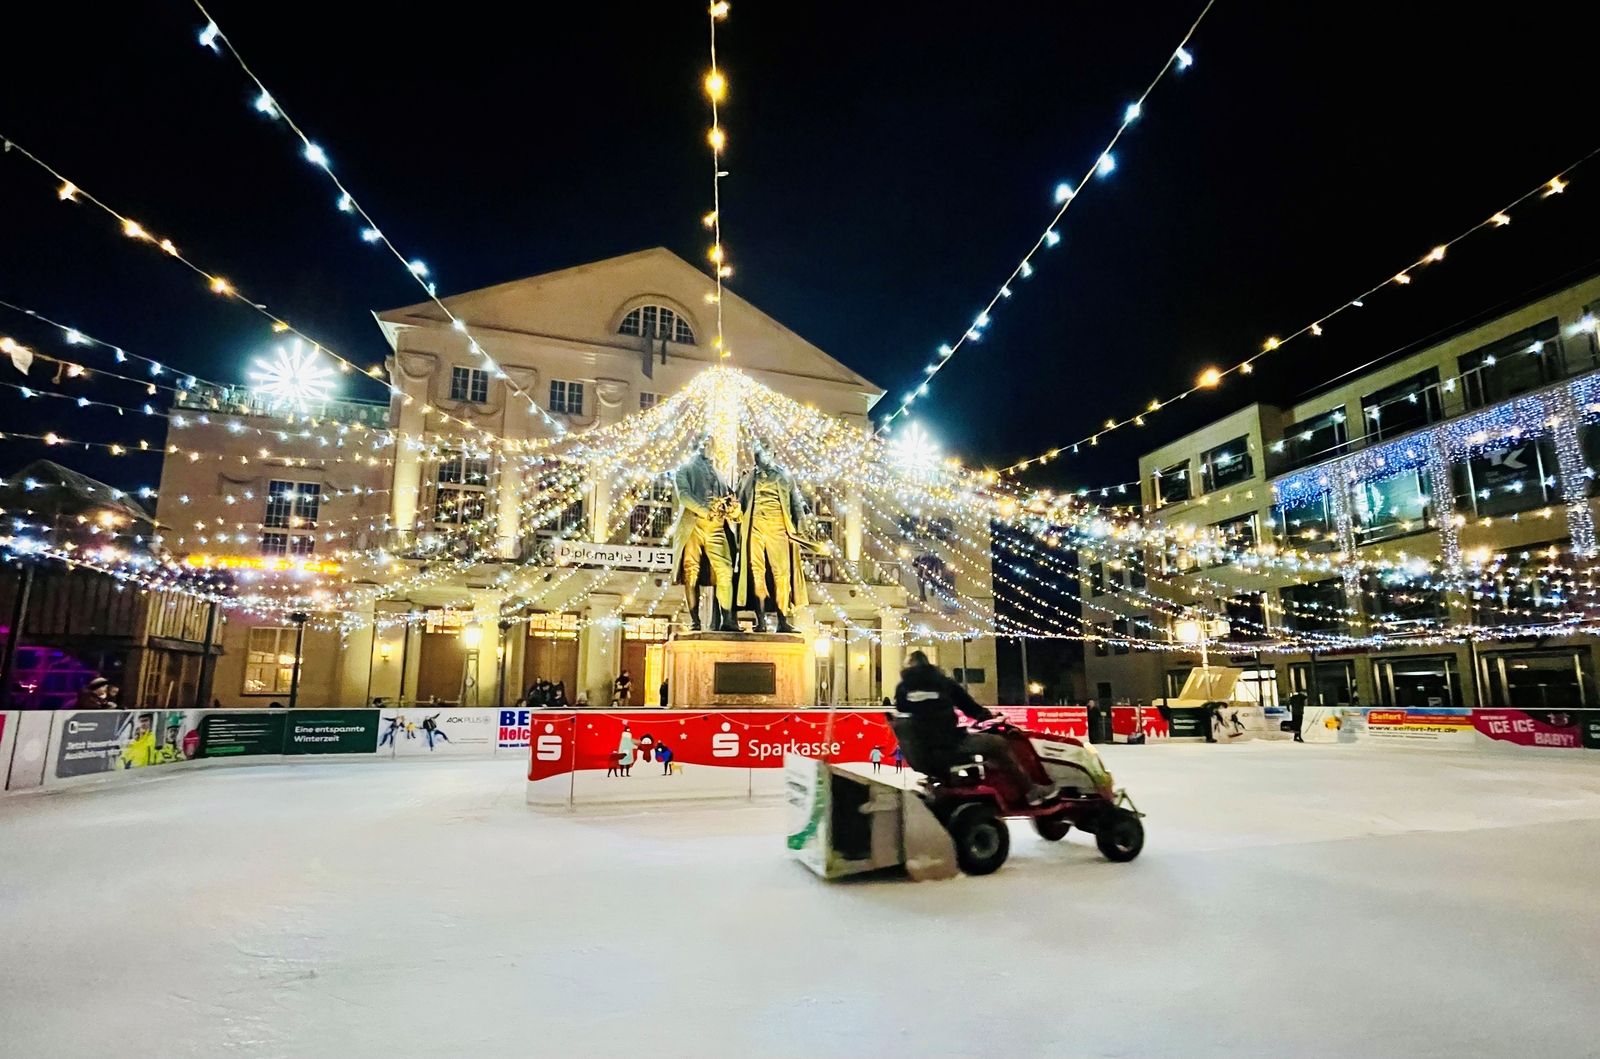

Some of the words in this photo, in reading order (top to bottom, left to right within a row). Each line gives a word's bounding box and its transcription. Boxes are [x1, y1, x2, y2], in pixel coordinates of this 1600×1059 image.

[561, 546, 633, 562] Dplomatie
[446, 716, 463, 724] AOK
[314, 725, 366, 734] entspannte
[1489, 721, 1511, 734] ICE
[1512, 719, 1535, 732] ICE
[293, 735, 340, 743] Winterzeit
[748, 738, 841, 760] Sparkasse
